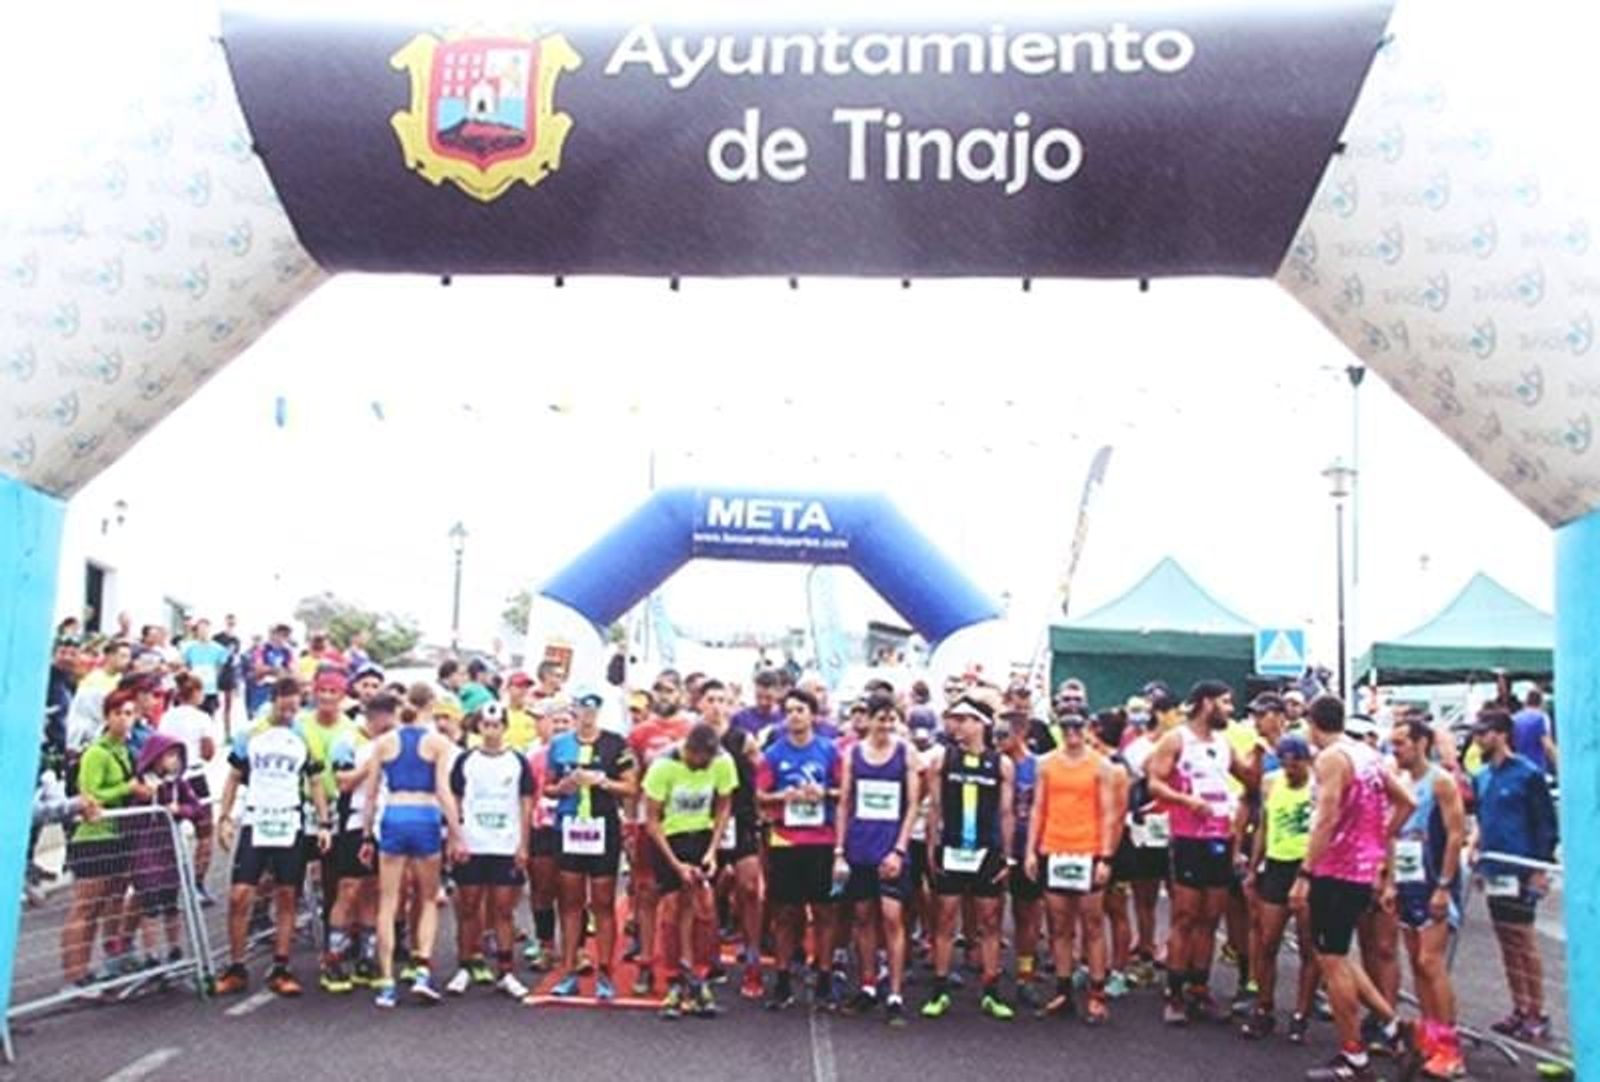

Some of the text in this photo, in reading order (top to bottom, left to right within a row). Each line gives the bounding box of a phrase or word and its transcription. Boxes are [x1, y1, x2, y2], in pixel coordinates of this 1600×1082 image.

[605, 22, 1194, 89] Ayuntamiento
[708, 107, 1083, 195] de Tinajo
[707, 497, 832, 532] META
